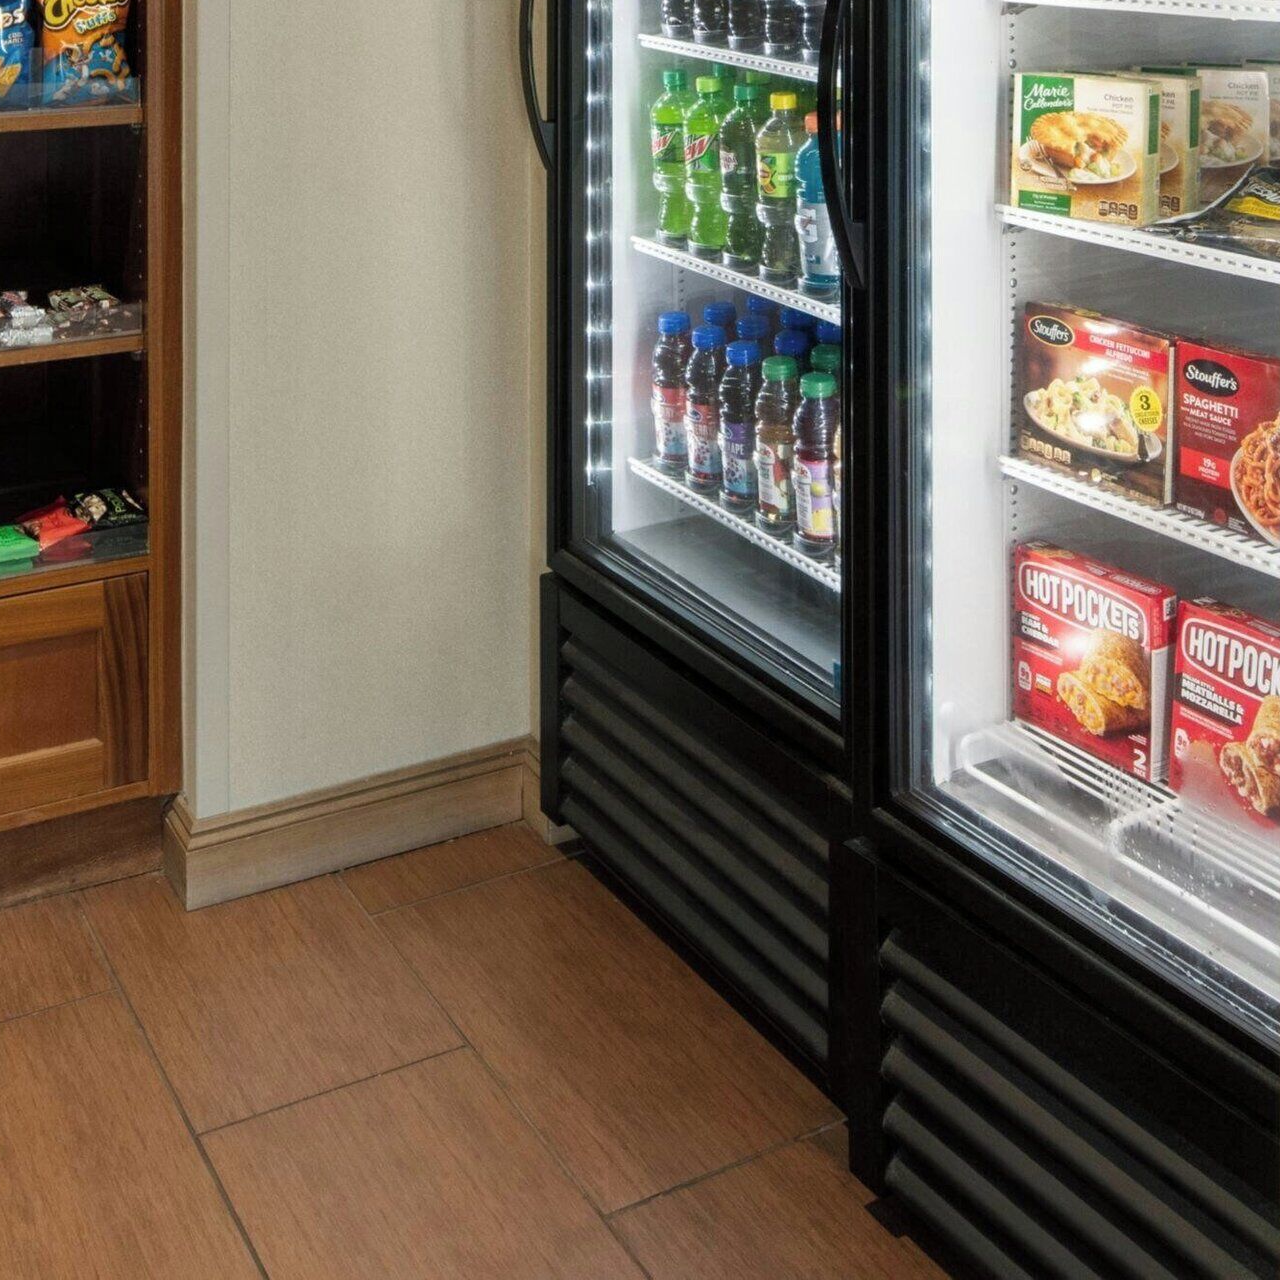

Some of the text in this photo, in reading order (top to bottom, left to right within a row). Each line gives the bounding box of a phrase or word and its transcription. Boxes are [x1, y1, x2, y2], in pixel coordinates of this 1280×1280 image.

[1024, 83, 1070, 99] Marie
[1227, 81, 1259, 90] Chicken
[1104, 93, 1135, 103] Chicken
[1033, 319, 1069, 342] Stouffer's
[1185, 364, 1238, 391] Stouffer's
[1139, 394, 1151, 411] 3
[1183, 392, 1238, 419] SPAGHETTI
[1189, 407, 1208, 420] MEAT
[1209, 413, 1232, 426] SAUCE
[1025, 569, 1060, 609] HOT
[1061, 577, 1139, 640] POCKETS
[1189, 626, 1229, 673] HOT
[1181, 688, 1243, 725] MOZZARELLA
[1182, 677, 1244, 715] MEATBALLS &
[1133, 748, 1147, 770] 2
